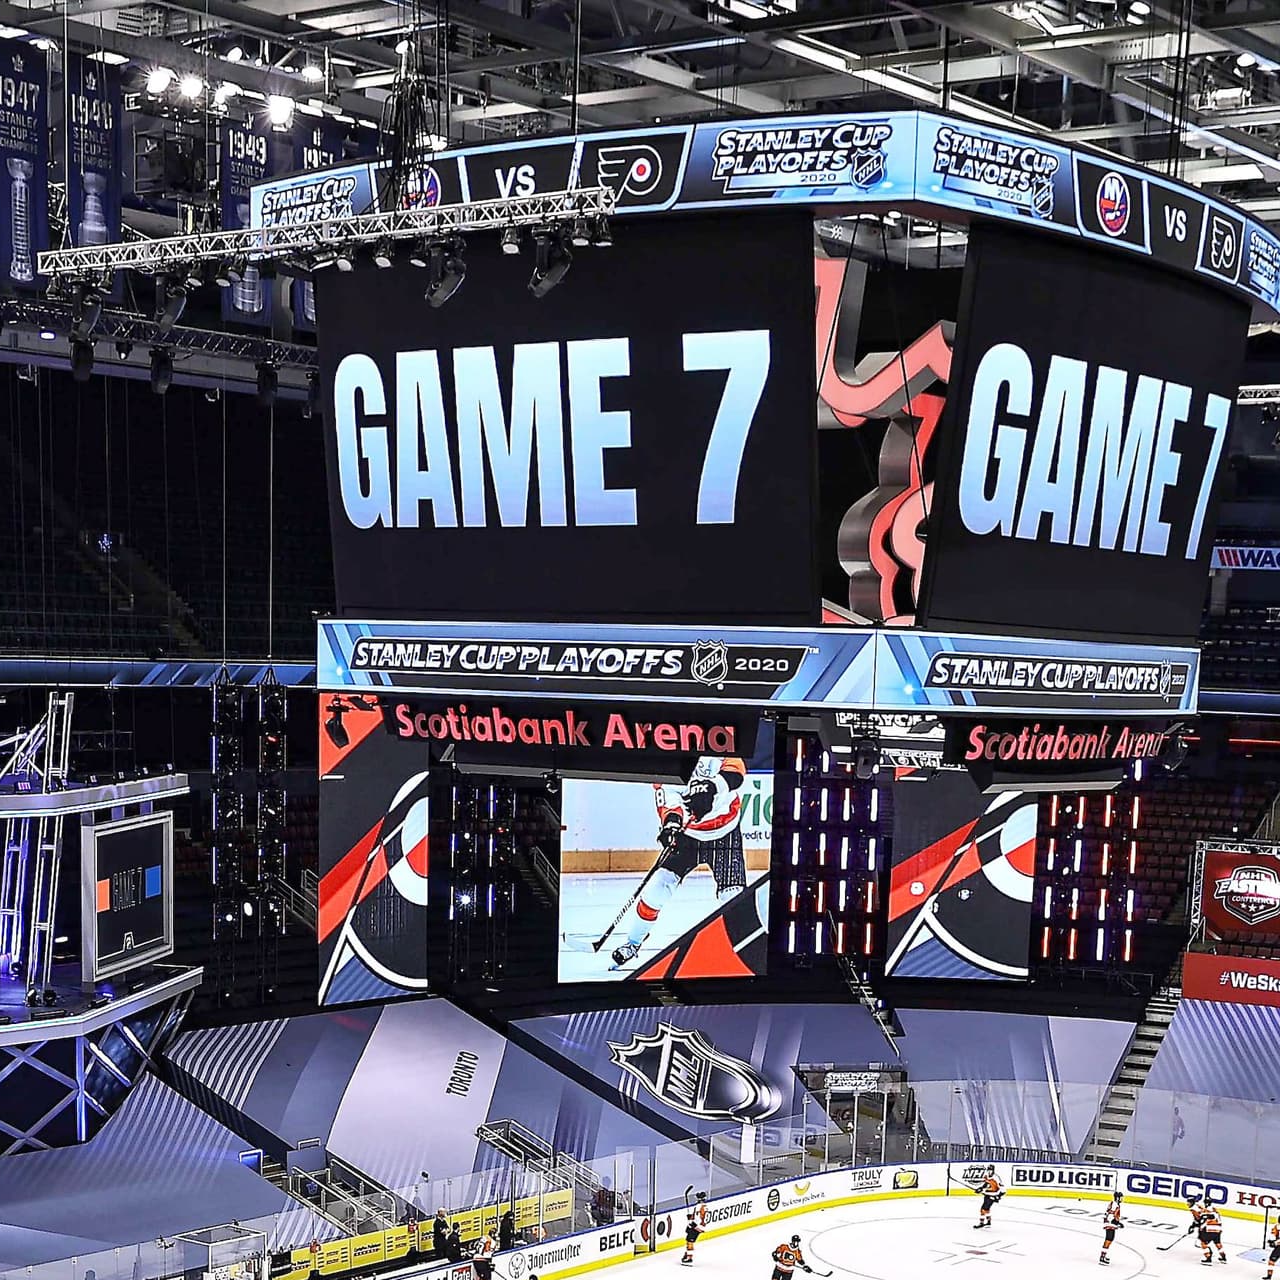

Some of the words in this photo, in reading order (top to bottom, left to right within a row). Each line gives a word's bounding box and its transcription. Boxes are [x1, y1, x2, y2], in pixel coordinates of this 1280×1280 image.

[10, 126, 28, 141] CUP
[229, 129, 267, 165] 1949
[717, 128, 832, 155] STANLEY
[832, 124, 893, 150] CUP
[936, 127, 1021, 166] STANLEY
[1019, 148, 1058, 174] CUP
[230, 162, 265, 178] STANLEY
[716, 150, 849, 176] PLAYOFFS
[800, 173, 837, 183] 2020
[857, 160, 880, 183] NHL
[935, 152, 1033, 191] PLAYOFFS
[262, 184, 322, 214] STANLEY
[321, 178, 356, 201] CUP
[495, 165, 536, 199] VS
[997, 189, 1023, 201] 2020
[262, 202, 331, 229] PLAYOFFS
[1164, 205, 1187, 241] VS
[333, 336, 638, 530] GAME
[681, 328, 772, 526] 7
[958, 341, 1208, 561] GAME
[1184, 392, 1234, 562] 7
[354, 641, 463, 669] STANLEY
[459, 644, 520, 670] CUP
[519, 645, 684, 677] PLAYOFFS
[697, 651, 724, 677] NHL
[734, 657, 790, 672] 2020
[931, 656, 1044, 688] STANLEY
[1040, 663, 1083, 689] CUP
[1082, 665, 1160, 692] PLAYOFFS
[395, 703, 589, 749] Scotiabank
[602, 713, 736, 753] Arena
[965, 723, 1109, 761] Scotiabank
[1111, 727, 1165, 759] Arena
[446, 1050, 479, 1098] TORONTO
[664, 1050, 700, 1107] NHL
[851, 1168, 883, 1183] TRULY
[1015, 1169, 1056, 1184] BUD
[1058, 1171, 1114, 1189] LIGHT
[1126, 1174, 1230, 1205] GEICO
[527, 1243, 583, 1271] Jägermeister
